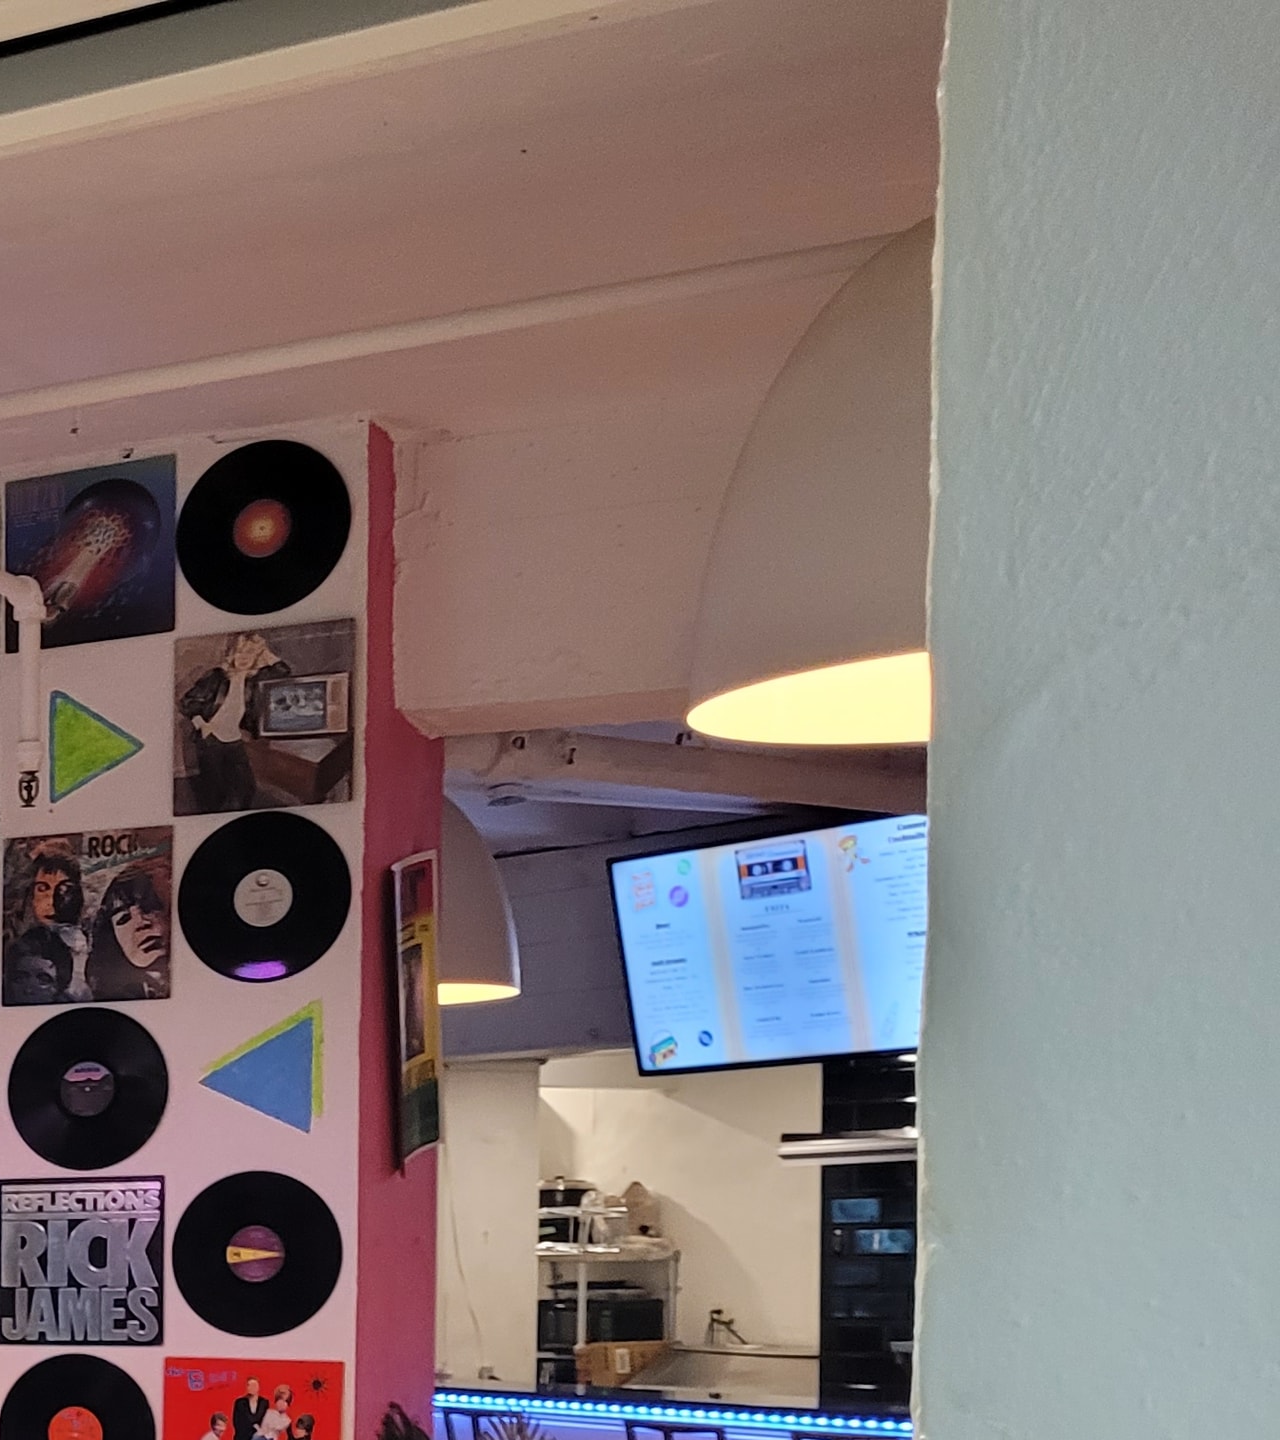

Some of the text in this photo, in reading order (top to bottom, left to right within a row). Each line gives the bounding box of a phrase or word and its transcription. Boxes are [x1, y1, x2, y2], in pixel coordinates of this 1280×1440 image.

[1, 1189, 161, 1212] REFLECTIONS
[1, 1218, 160, 1287] RICK
[1, 1286, 159, 1342] JAMES
